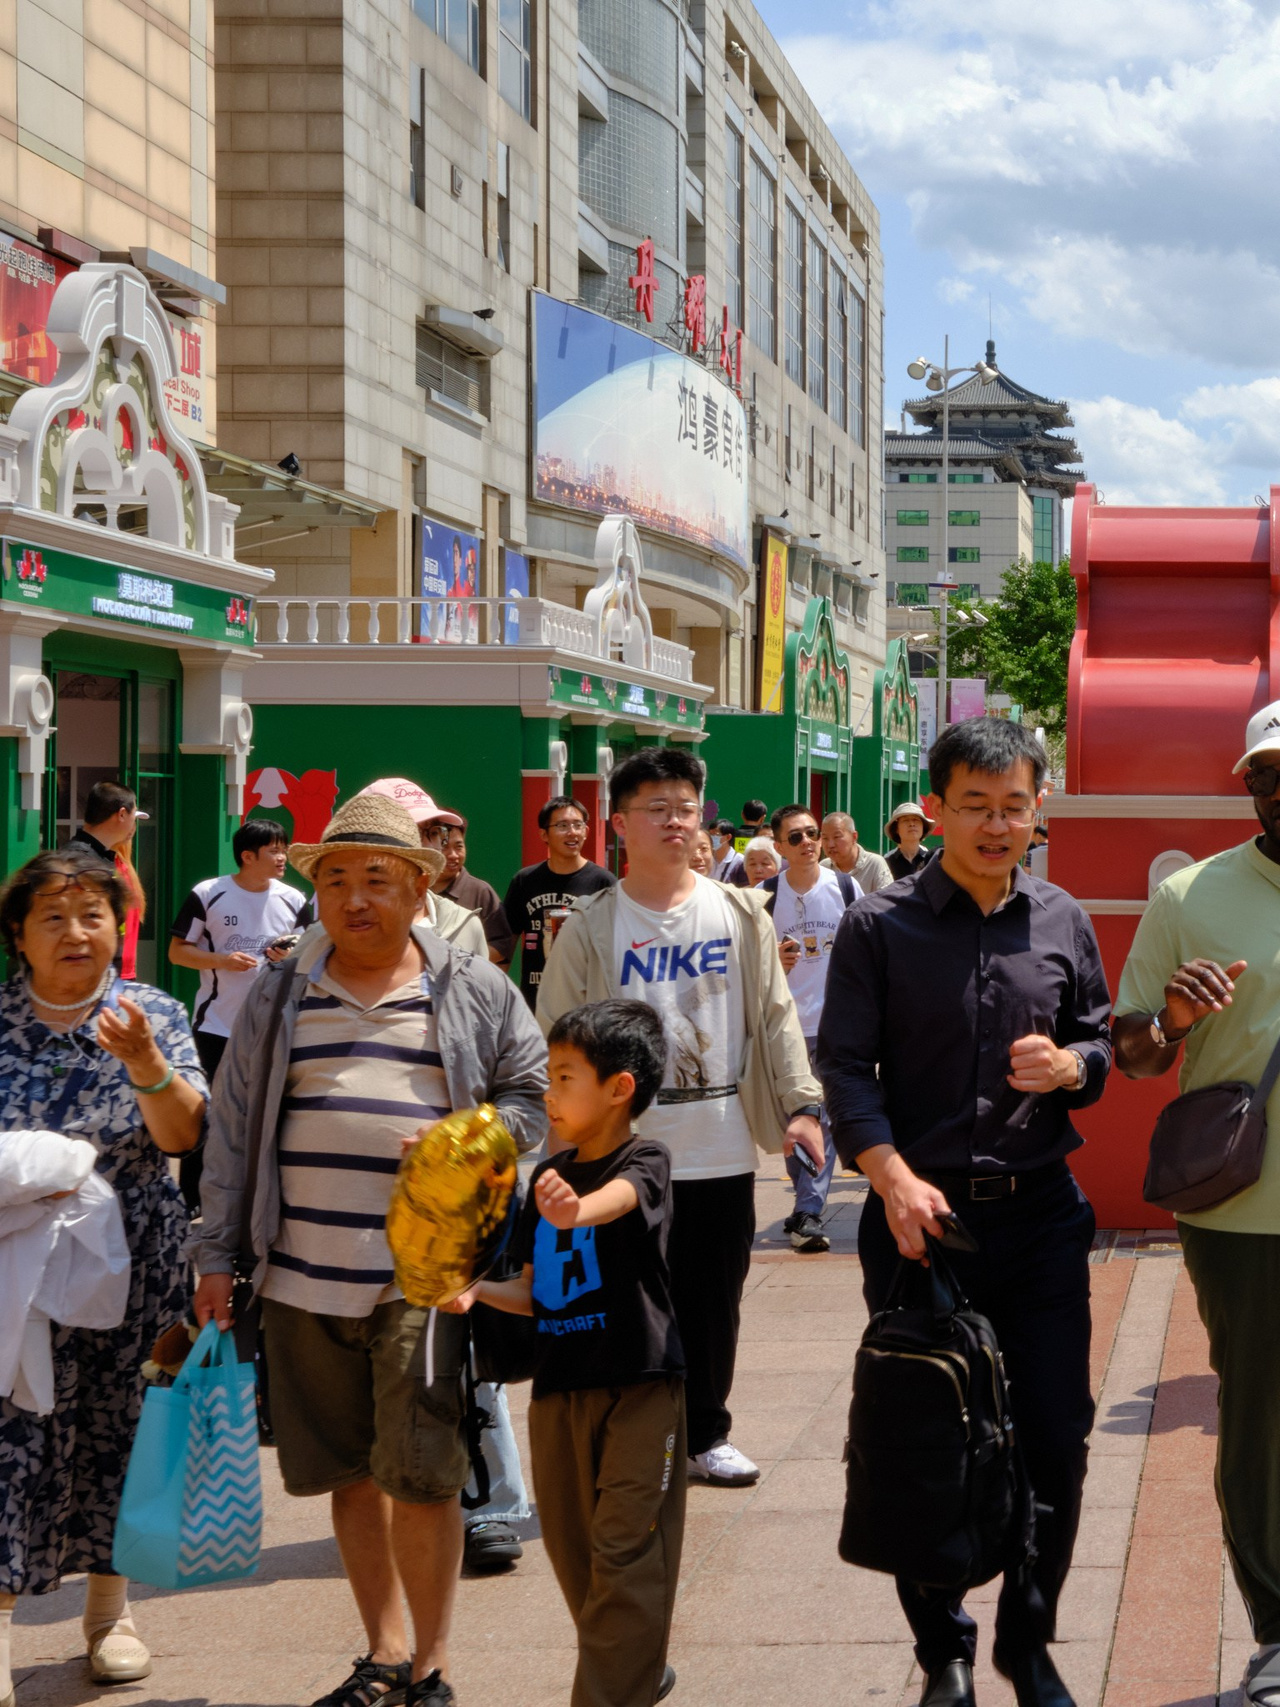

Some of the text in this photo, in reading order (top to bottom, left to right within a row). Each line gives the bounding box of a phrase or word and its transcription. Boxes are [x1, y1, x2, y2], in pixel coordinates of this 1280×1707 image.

[181, 380, 200, 402] Shop
[191, 404, 202, 423] B2
[117, 572, 174, 608] 莫斯科交通
[151, 610, 194, 630] ТРАНСПОРТ
[224, 915, 238, 926] 30
[531, 920, 541, 931] 19
[782, 920, 837, 935] NAUGHTY BEAR
[620, 938, 732, 986] NIKE
